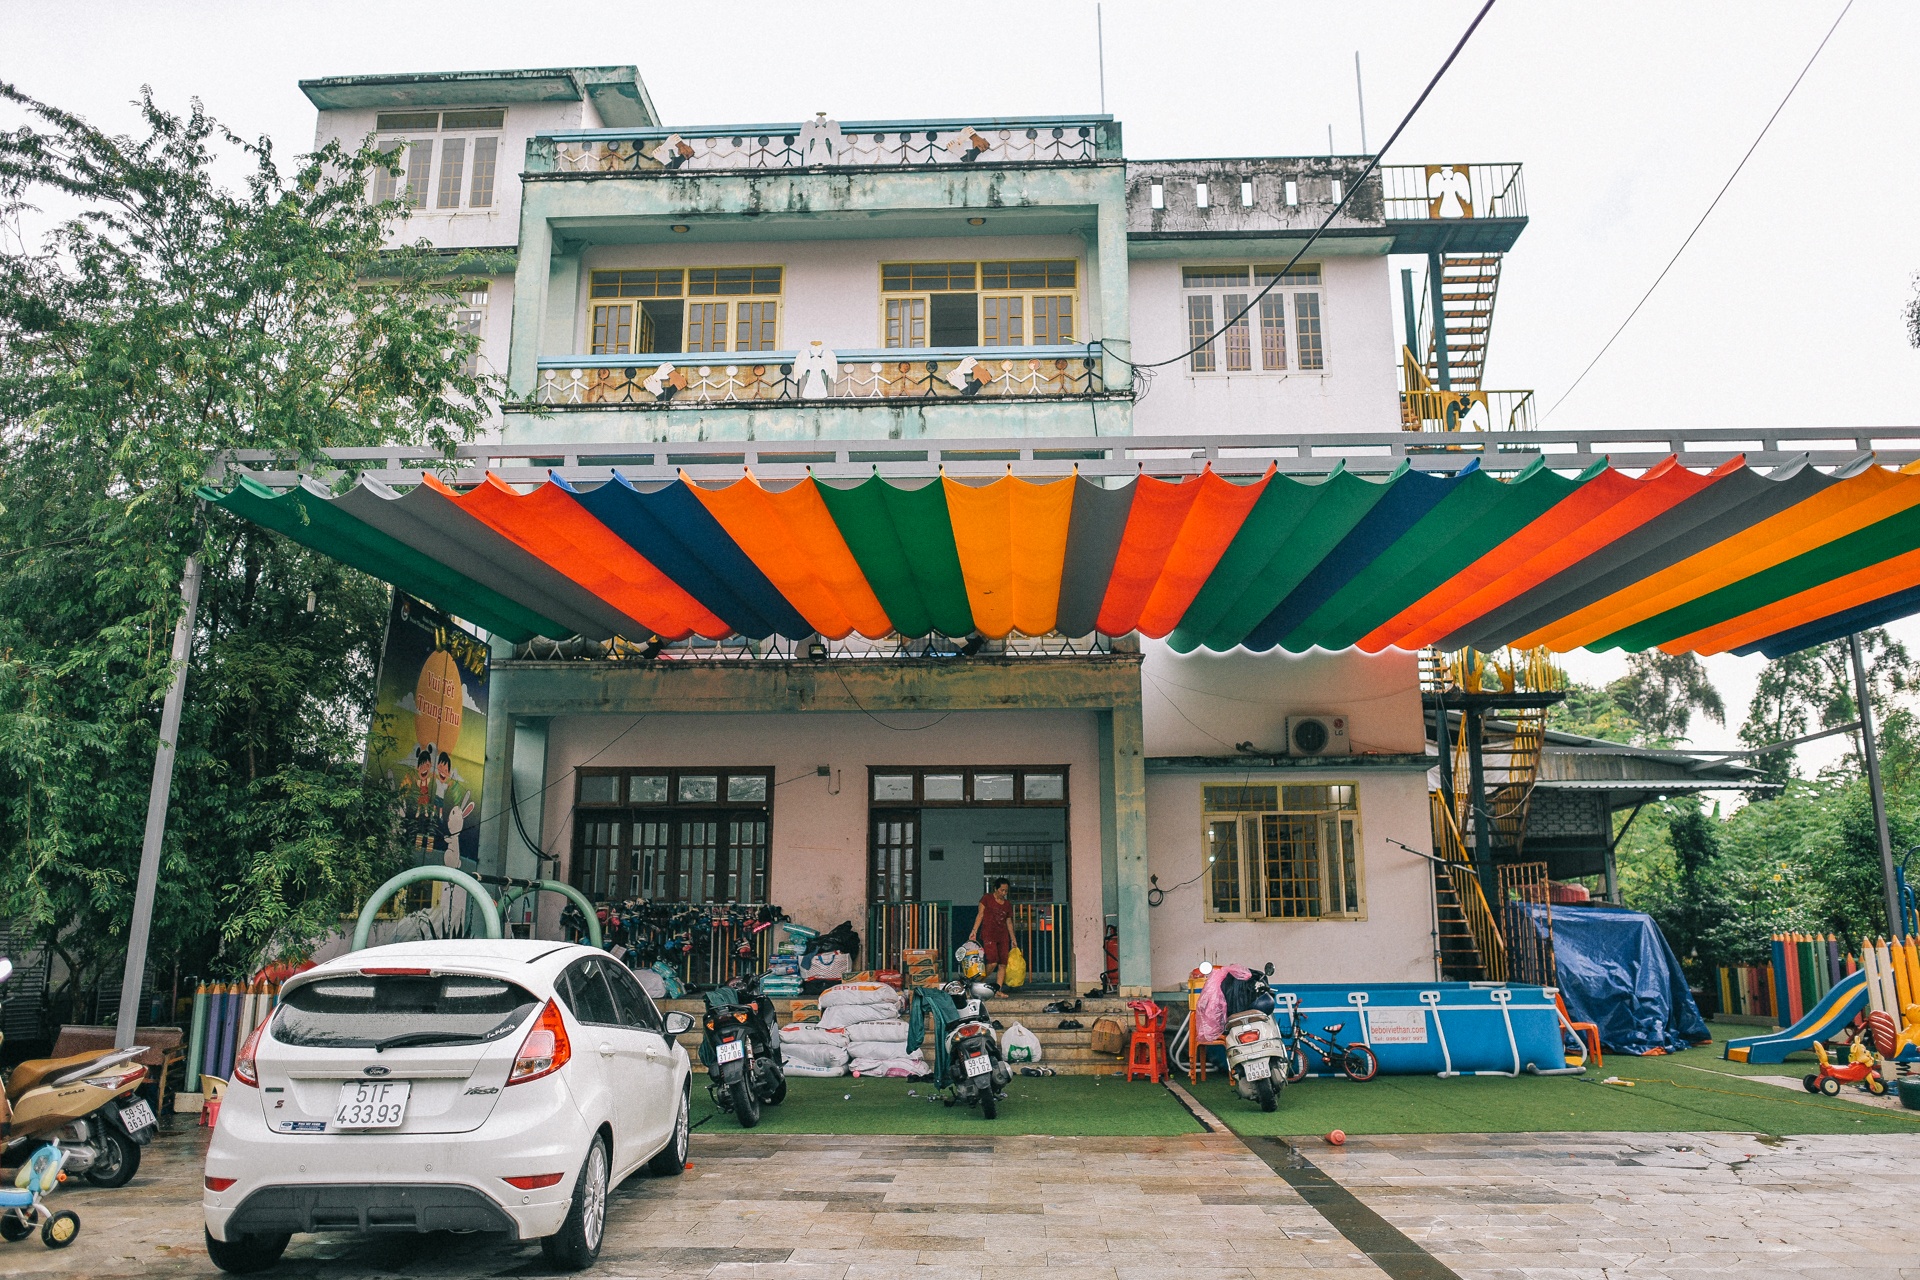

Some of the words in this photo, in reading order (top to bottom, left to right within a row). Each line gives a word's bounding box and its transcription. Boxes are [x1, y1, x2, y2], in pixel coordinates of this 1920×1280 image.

[428, 671, 440, 693] Vui
[443, 679, 455, 699] Tết
[418, 695, 443, 724] Trung
[445, 705, 460, 727] Thu
[1370, 1025, 1426, 1034] beboiviethan.com
[968, 1063, 990, 1075] 371.02
[356, 1084, 394, 1103] 51F
[128, 1112, 154, 1131] 363.72
[336, 1104, 402, 1124] 433.93
